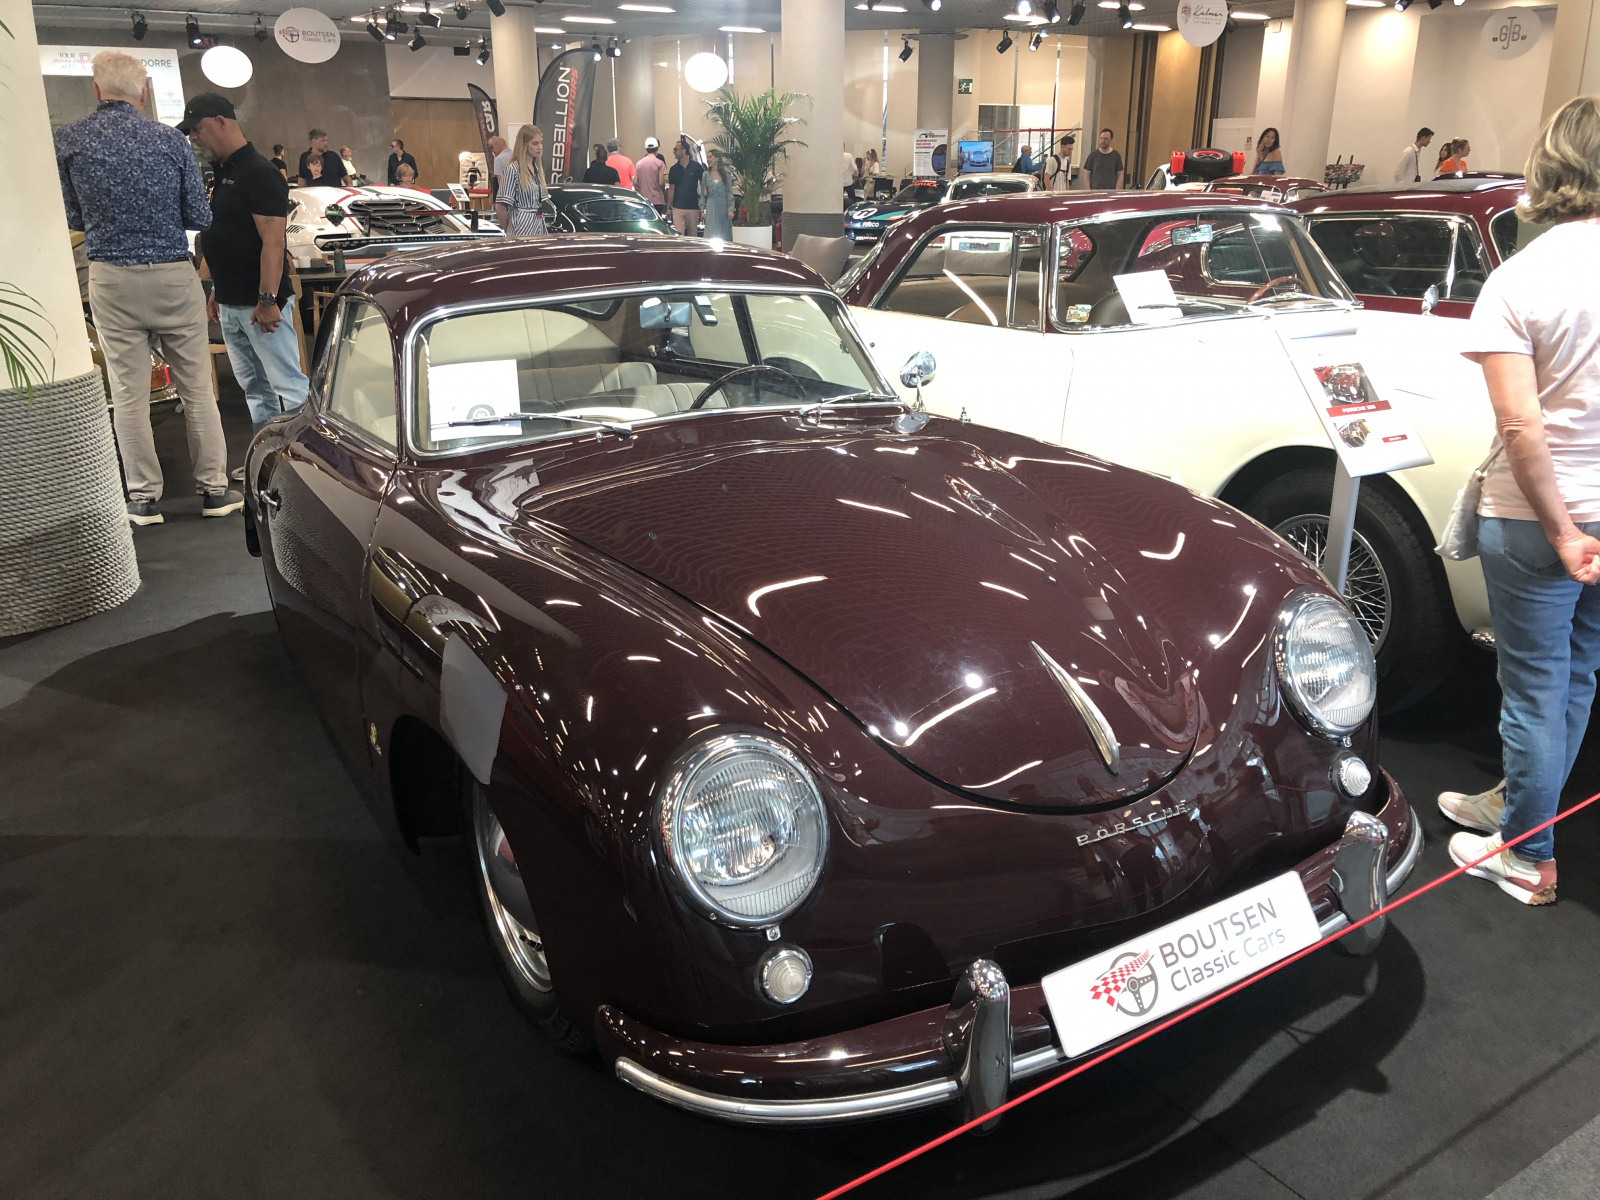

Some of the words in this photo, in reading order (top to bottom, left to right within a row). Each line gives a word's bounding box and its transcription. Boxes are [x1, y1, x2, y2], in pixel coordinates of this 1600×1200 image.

[301, 30, 336, 38] BOUTSEN
[551, 66, 571, 184] REBELLION
[1076, 803, 1188, 846] PORSCHE
[1159, 898, 1278, 968] BOUTSEN
[1170, 949, 1240, 992] Classic
[1243, 926, 1286, 958] Cars
